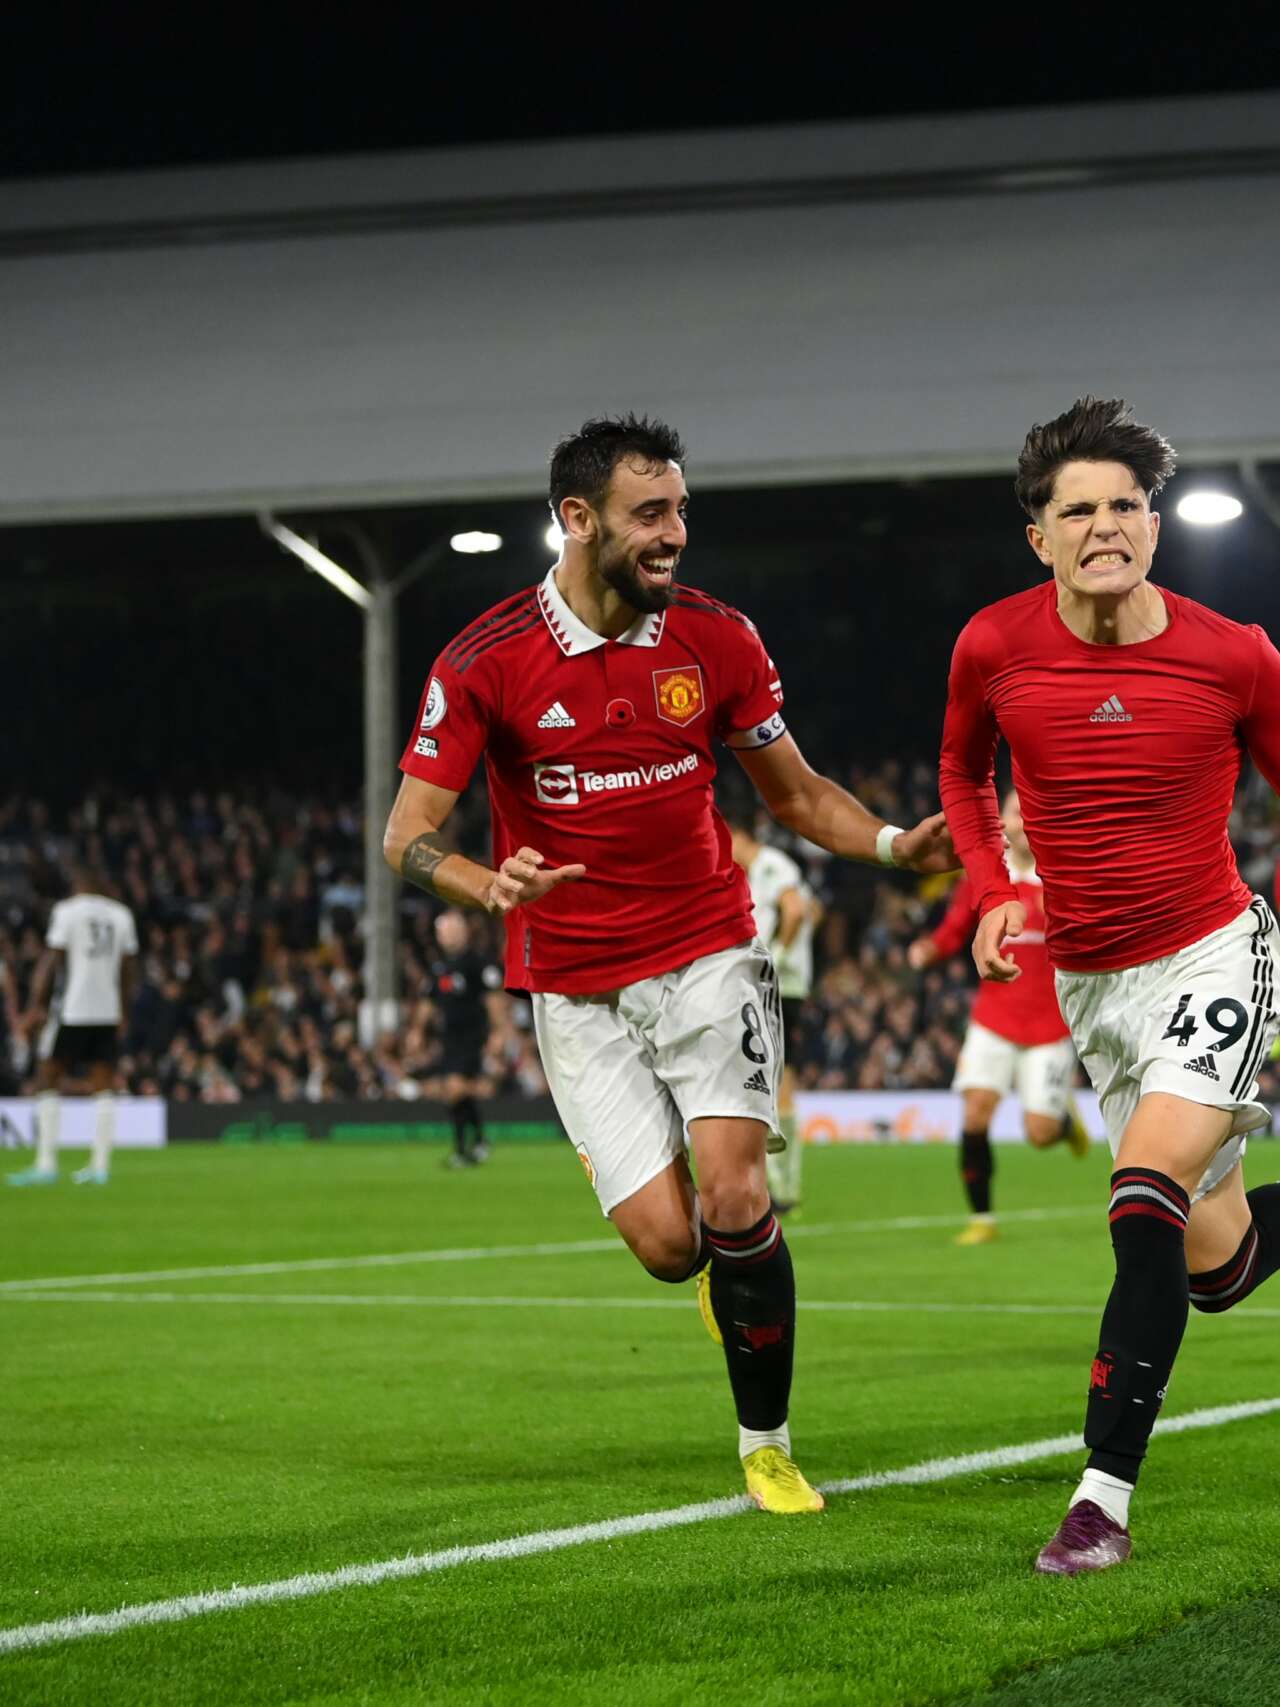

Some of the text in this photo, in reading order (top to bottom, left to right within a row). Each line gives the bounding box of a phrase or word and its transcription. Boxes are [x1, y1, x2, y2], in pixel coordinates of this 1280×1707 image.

[537, 718, 576, 728] adidas
[1089, 712, 1133, 722] adidas
[578, 753, 699, 792] TeamViewer
[741, 1002, 769, 1064] 8
[1161, 993, 1249, 1053] 49
[1183, 1062, 1220, 1082] adidas
